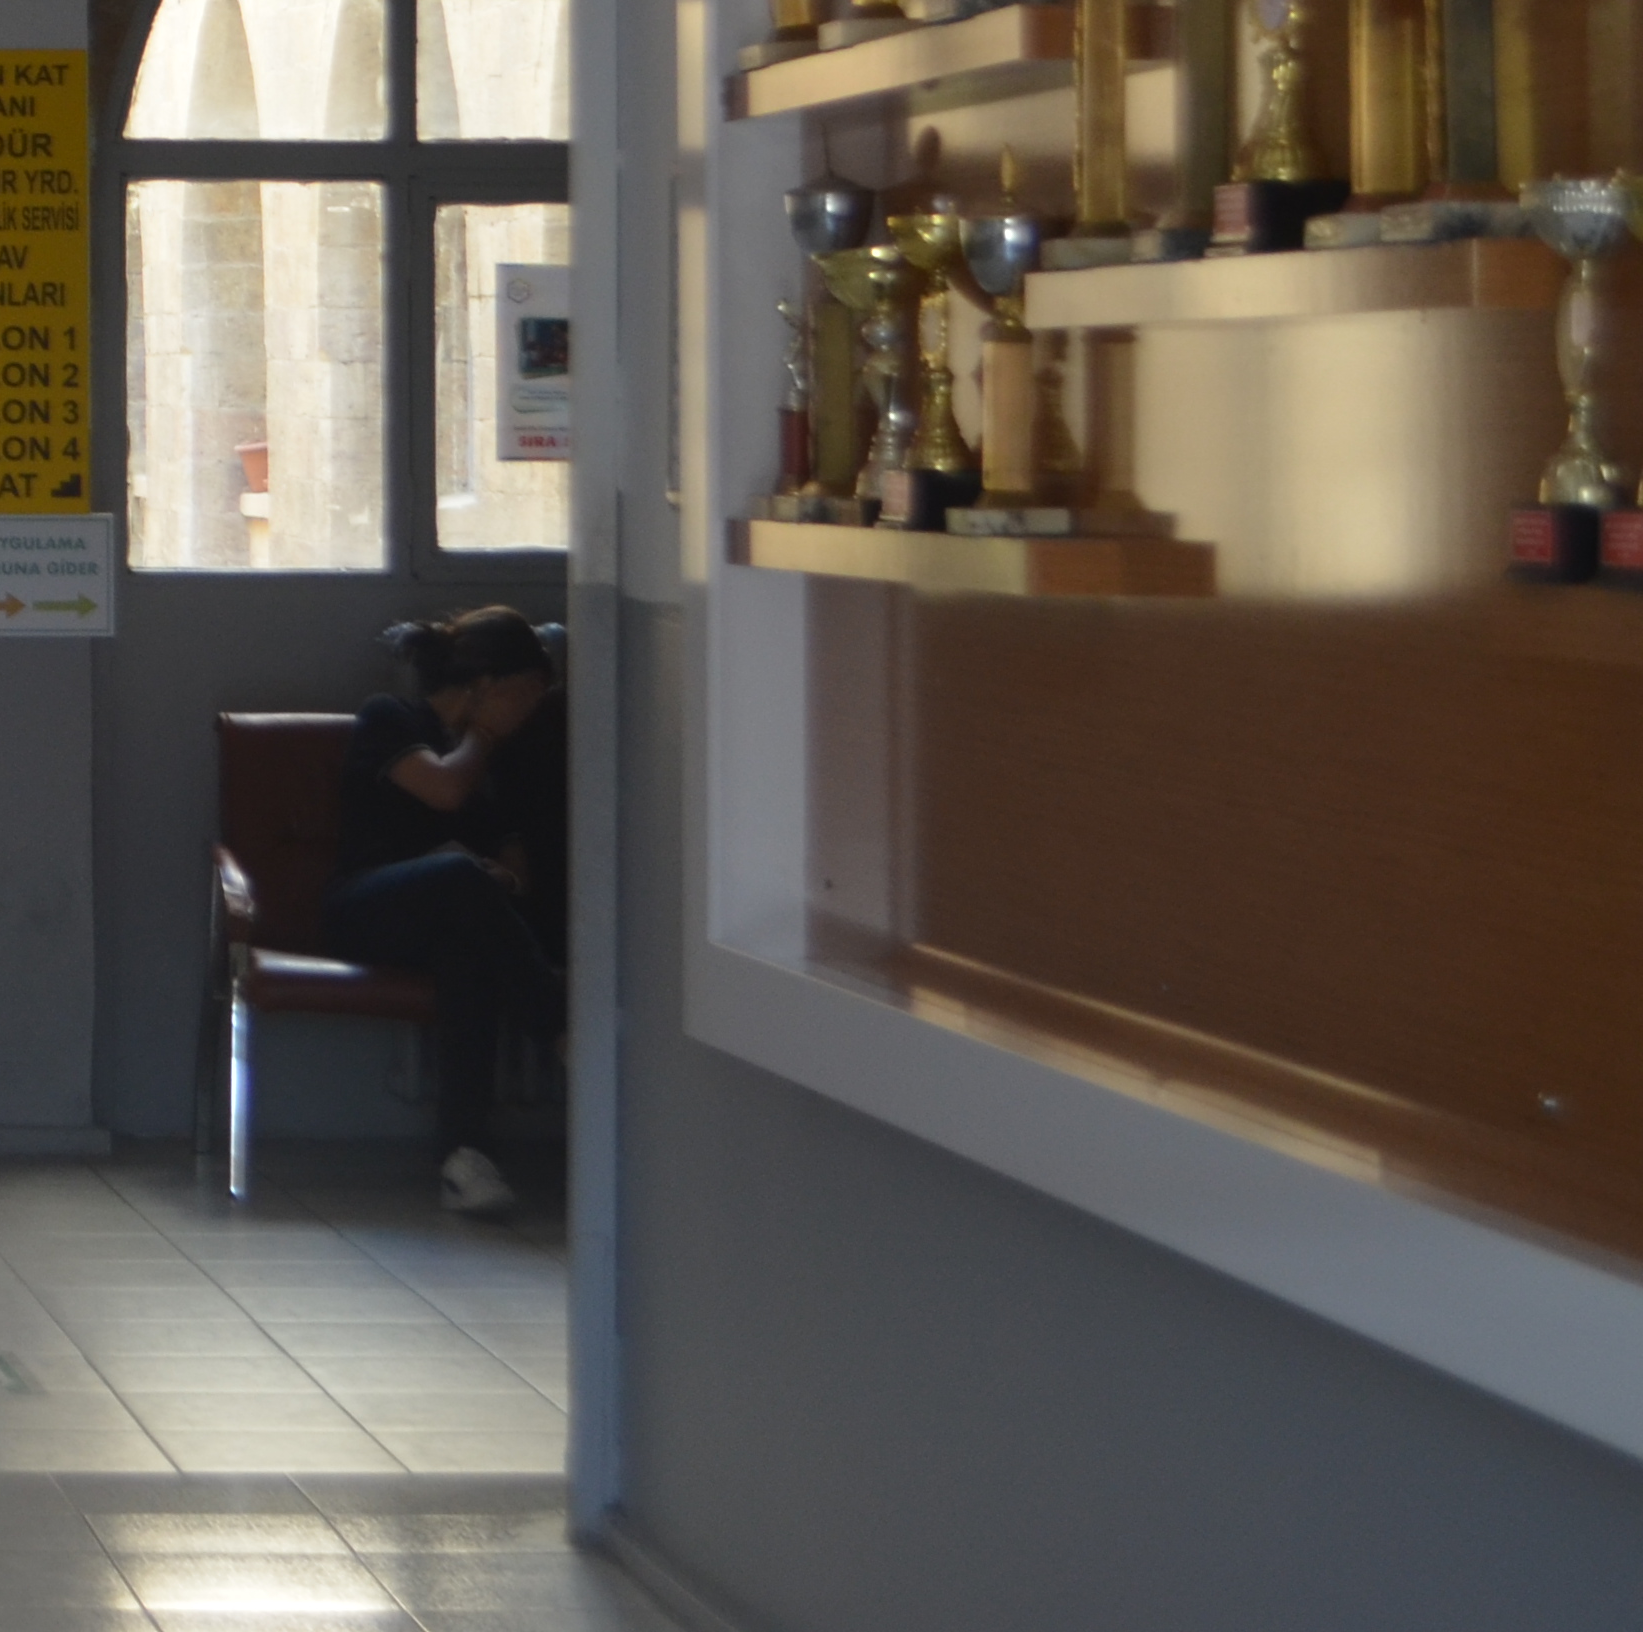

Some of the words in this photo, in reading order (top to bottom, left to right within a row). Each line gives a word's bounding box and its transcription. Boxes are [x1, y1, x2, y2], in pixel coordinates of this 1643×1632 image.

[15, 65, 69, 86] KAT
[24, 170, 80, 195] YRD.
[22, 201, 80, 231] SERVİSİ
[62, 326, 77, 351] 1
[62, 362, 80, 388] 2
[62, 399, 80, 425] 3
[62, 436, 82, 462] 4
[47, 558, 99, 576] GİDER
